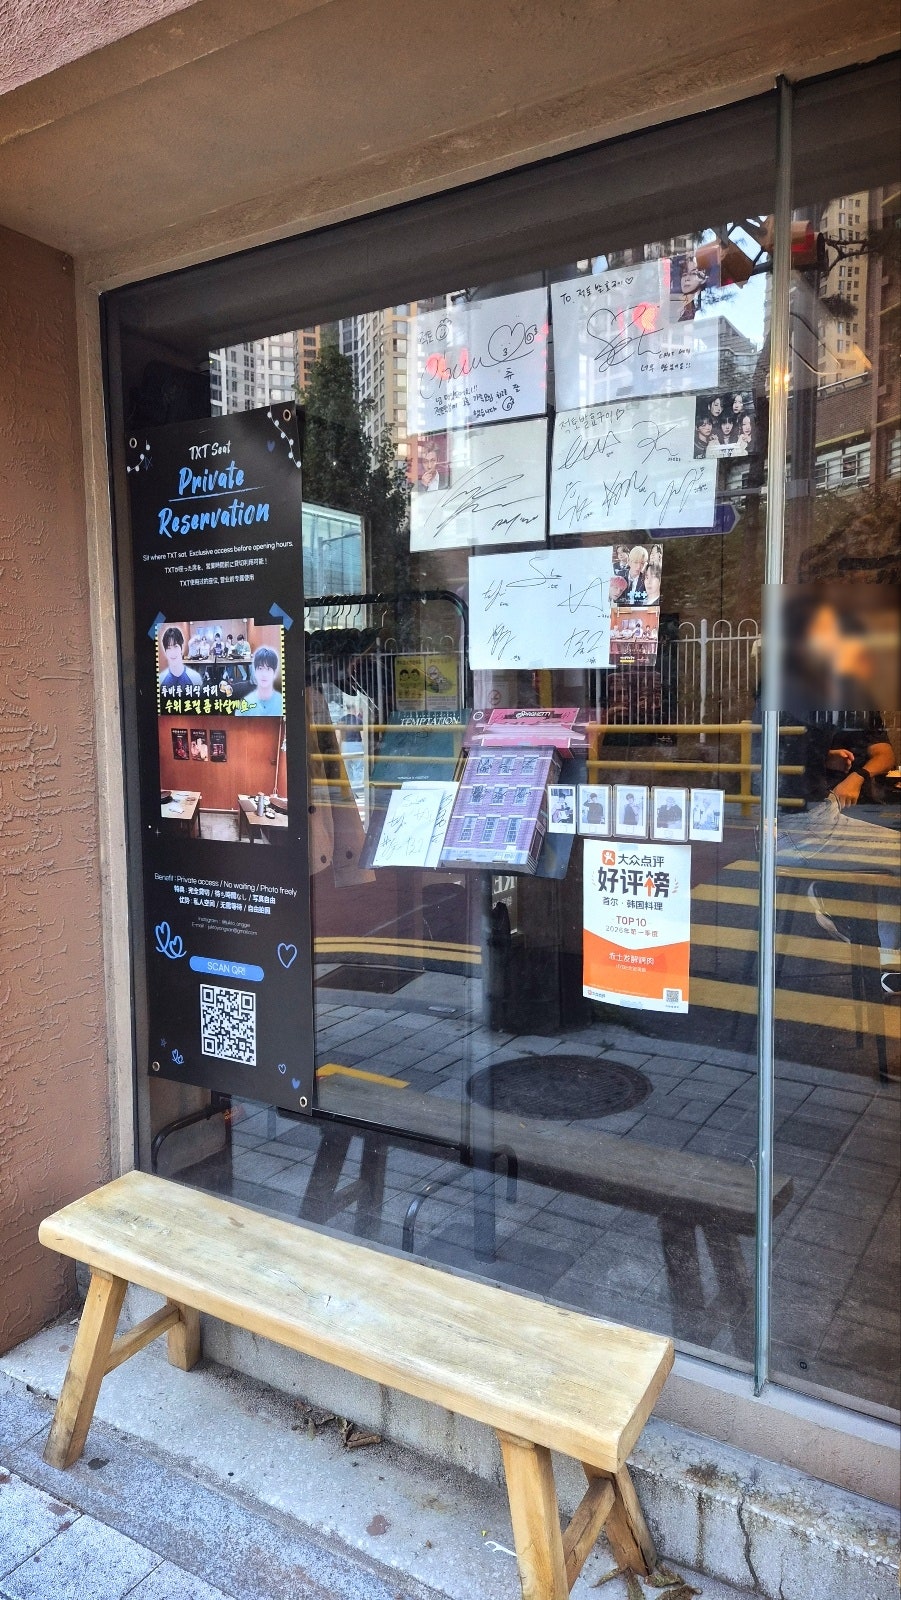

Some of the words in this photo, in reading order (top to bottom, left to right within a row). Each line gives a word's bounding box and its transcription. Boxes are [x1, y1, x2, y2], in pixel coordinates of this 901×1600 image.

[188, 443, 211, 460] TXT
[211, 440, 231, 457] Seat
[178, 460, 245, 495] Private
[158, 499, 270, 538] Reservation
[189, 549, 214, 557] Exclusive
[213, 547, 234, 555] access
[233, 544, 252, 553] before
[252, 542, 276, 552] opening
[161, 684, 183, 698] 투바투
[185, 683, 201, 698] 회식
[203, 684, 218, 697] 자리
[165, 699, 182, 714] 수위
[184, 699, 202, 714] 조절
[203, 698, 212, 714] 좀
[400, 716, 461, 726] TEMPTATION
[618, 853, 665, 868] 大众点评
[154, 872, 174, 882] Benefit
[177, 875, 197, 885] Private
[198, 878, 219, 887] access
[224, 881, 233, 889] No
[233, 882, 256, 892] waiting
[260, 885, 279, 894] Photo
[279, 886, 298, 897] freely
[597, 866, 670, 898] 好评榜
[602, 897, 619, 907] 首尔
[627, 899, 664, 912] 韩国料理
[207, 961, 230, 973] SCAN
[231, 964, 246, 976] QR!
